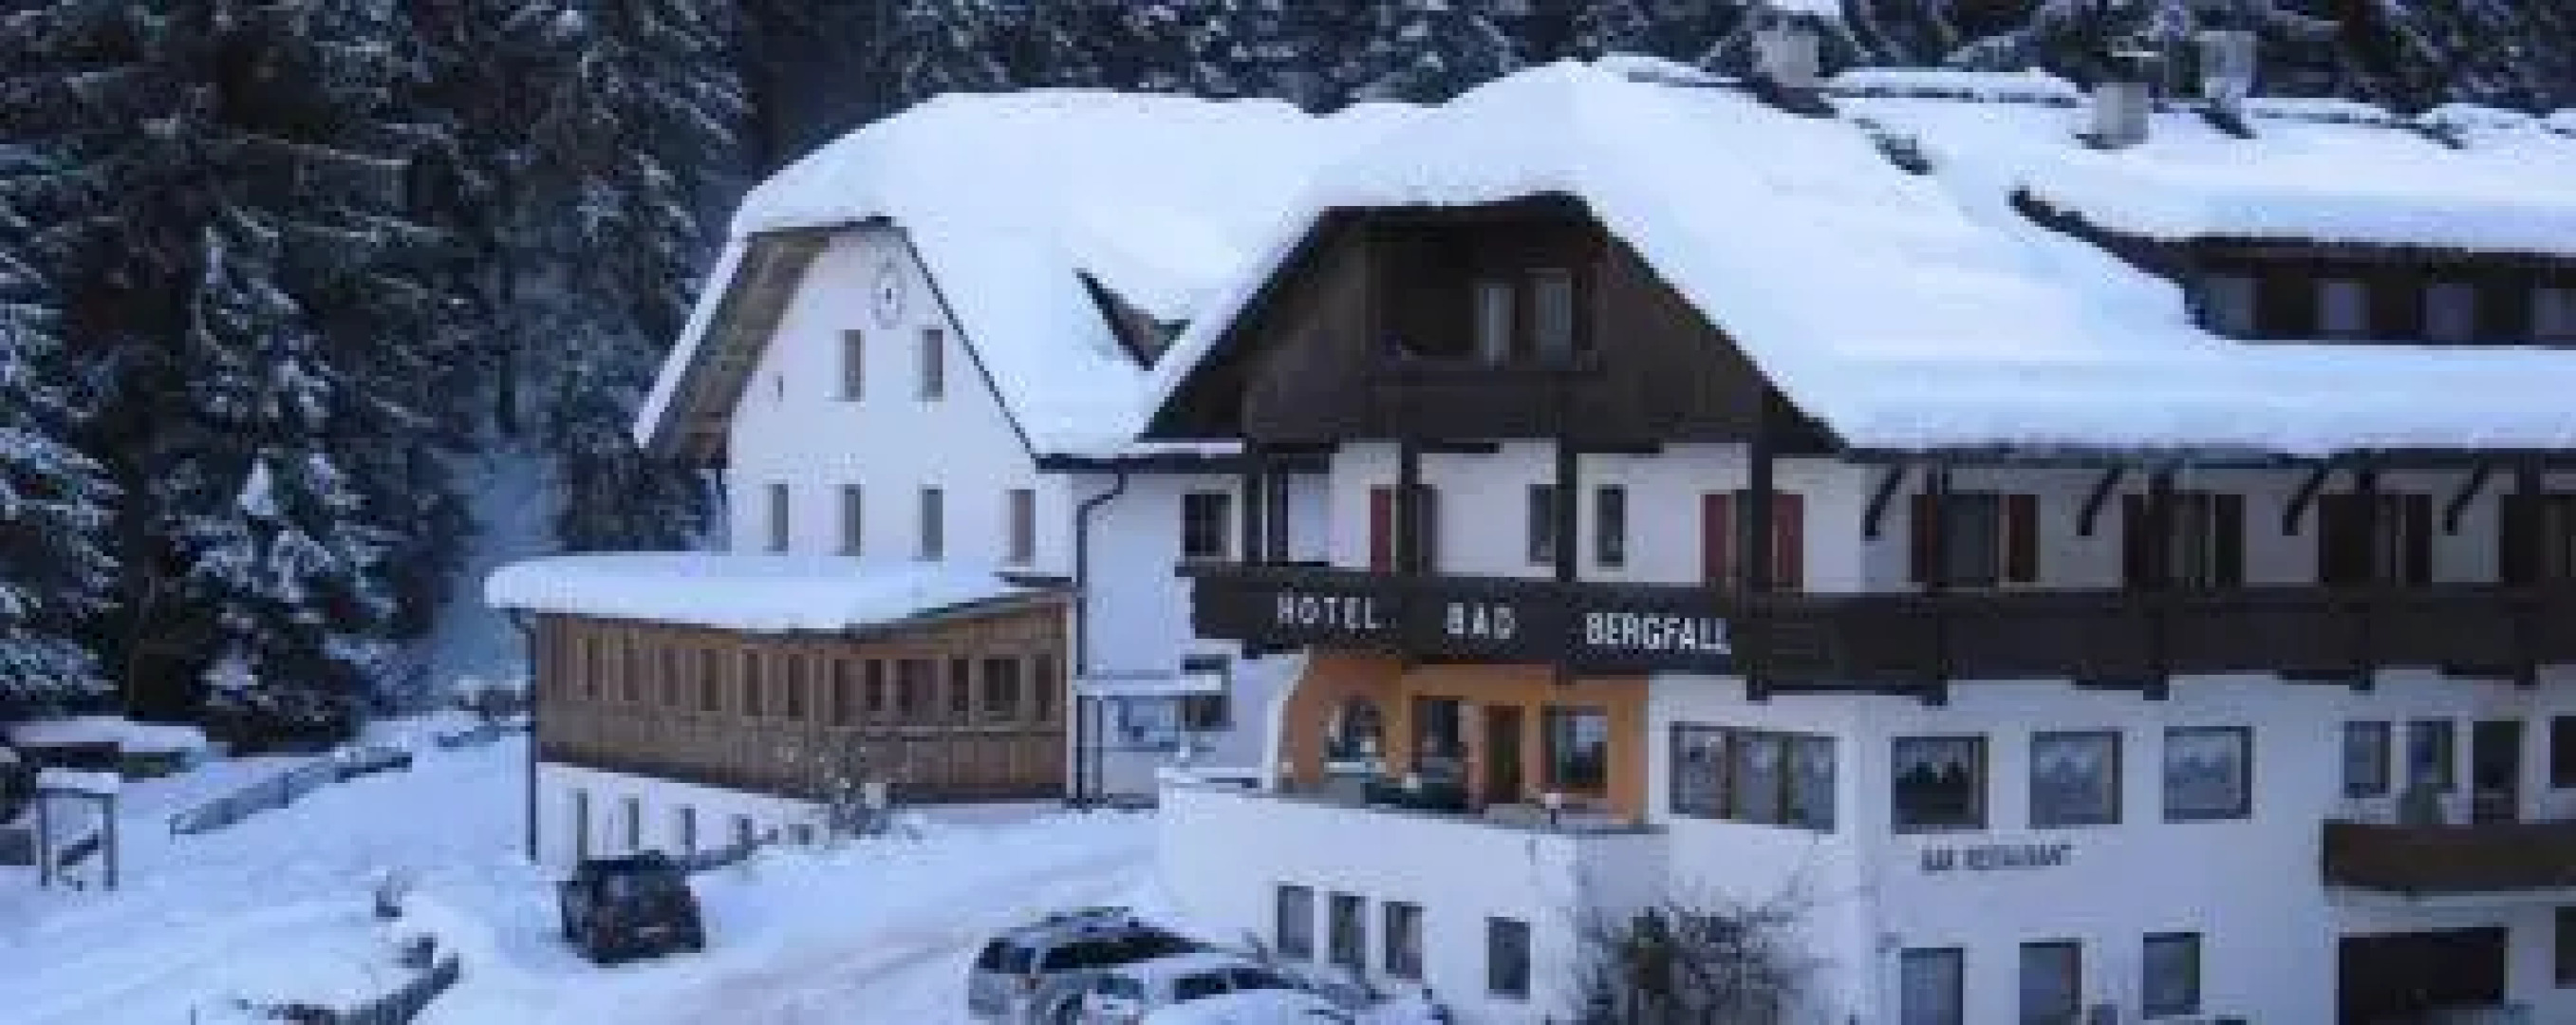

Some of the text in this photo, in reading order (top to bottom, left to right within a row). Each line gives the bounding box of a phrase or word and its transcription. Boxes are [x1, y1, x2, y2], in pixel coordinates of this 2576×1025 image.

[1277, 595, 1732, 656] HOTEL BAD BERGFALL
